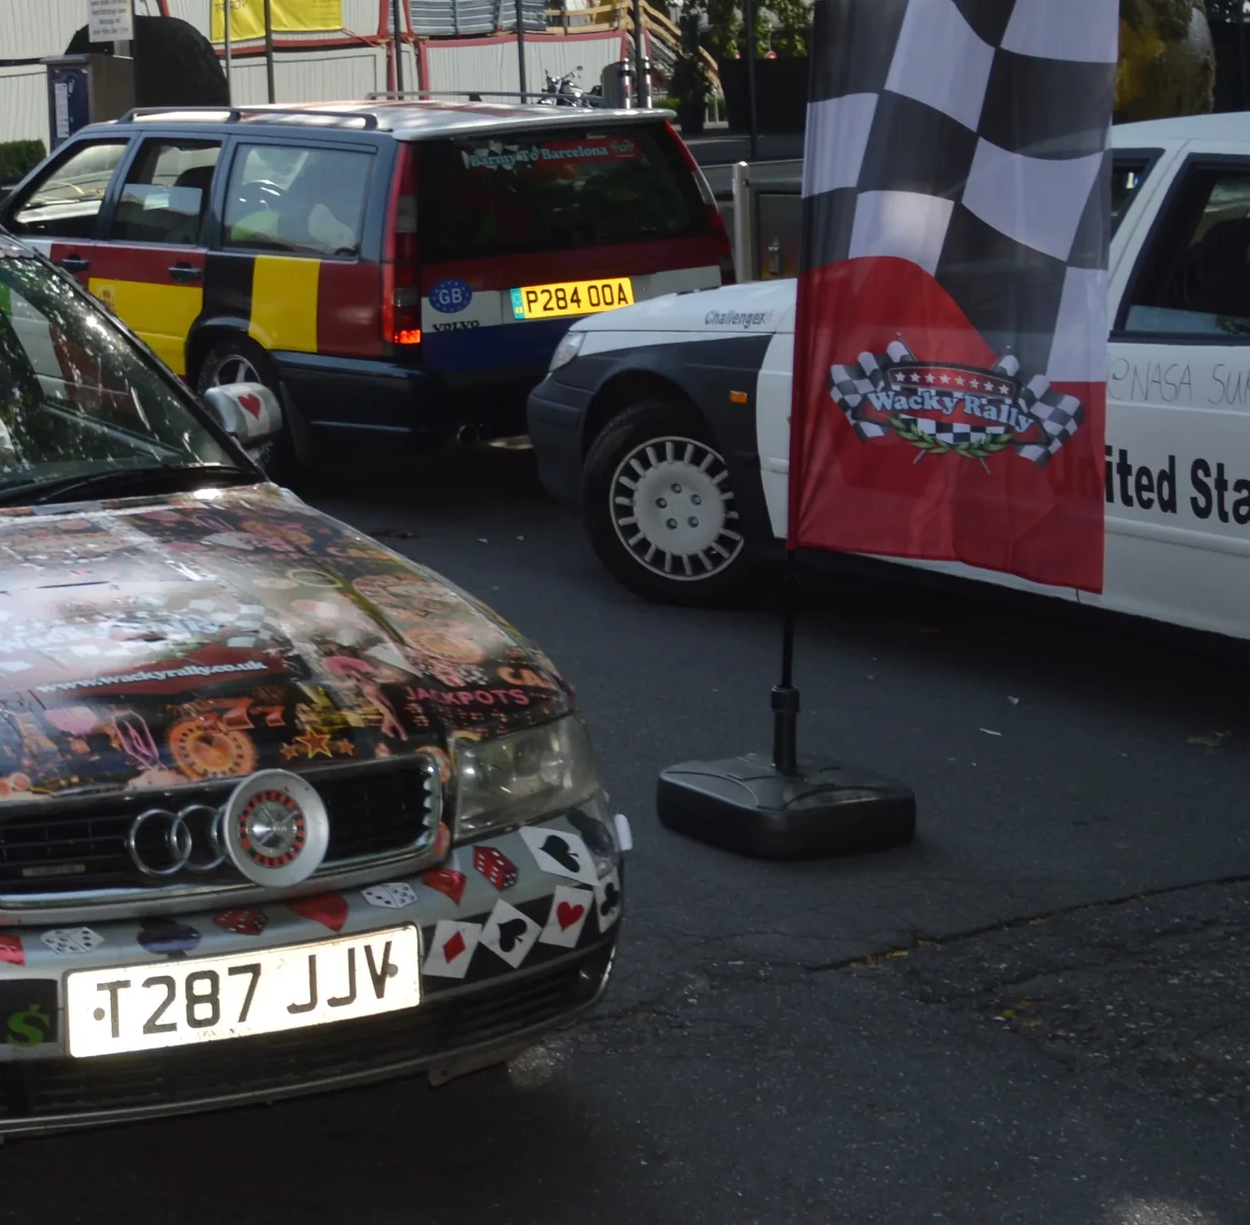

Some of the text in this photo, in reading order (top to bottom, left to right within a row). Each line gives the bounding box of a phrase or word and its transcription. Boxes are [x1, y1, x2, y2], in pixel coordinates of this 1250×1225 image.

[470, 153, 517, 168] Barmy
[519, 150, 538, 161] To
[542, 145, 608, 160] Barcelona
[439, 288, 462, 304] GB
[525, 287, 581, 313] P284
[432, 319, 479, 332] VOLVO
[867, 391, 1034, 432] Wacky Rally
[36, 659, 267, 695] www.wackyrally.co.uk
[406, 686, 529, 706] JACKPOTS
[97, 941, 393, 1038] T287 JJV
